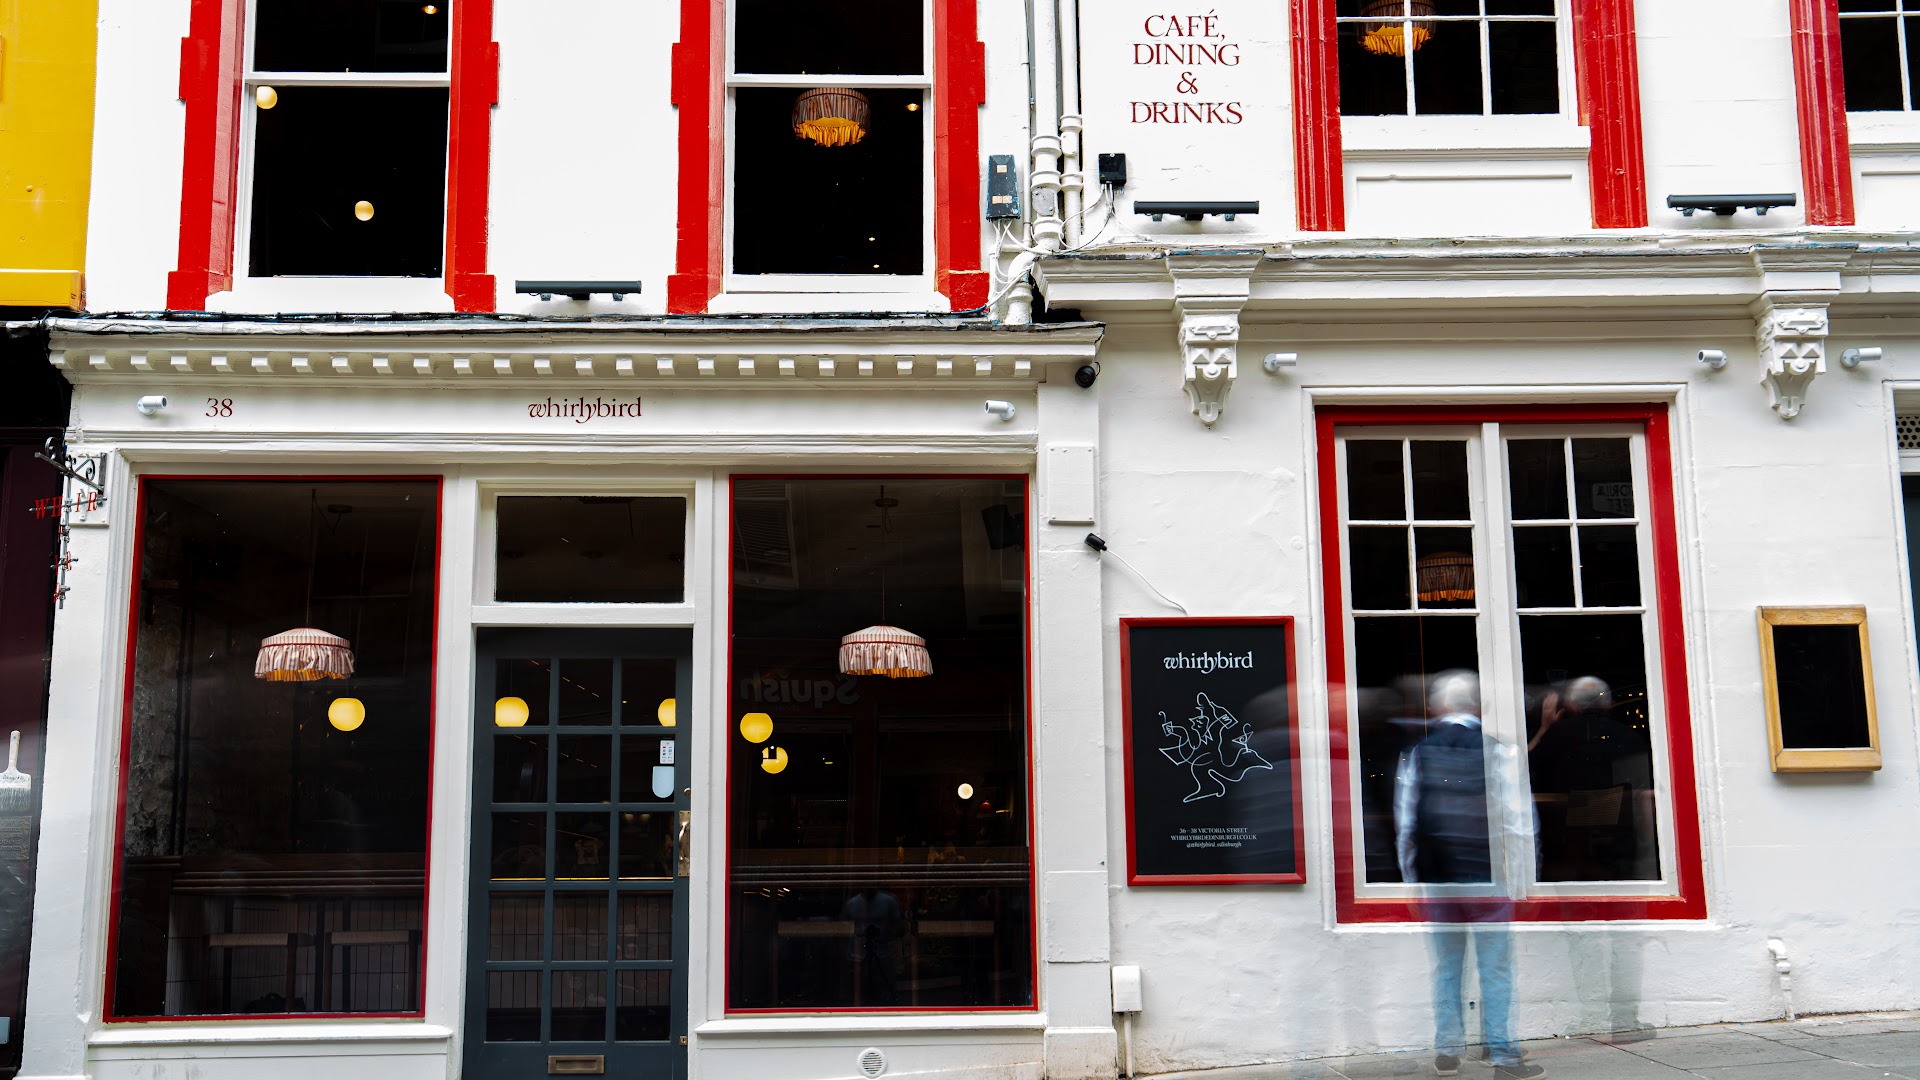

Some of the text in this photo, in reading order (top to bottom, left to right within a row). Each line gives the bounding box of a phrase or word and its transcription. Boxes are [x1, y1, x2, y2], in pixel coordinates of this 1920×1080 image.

[1144, 8, 1226, 42] CAFÉ,
[1132, 43, 1241, 67] DINING
[1176, 71, 1199, 95] &
[1129, 101, 1243, 125] DRINKS
[205, 397, 233, 418] 38
[527, 396, 643, 424] whirlybird
[1163, 651, 1254, 675] whirlybird
